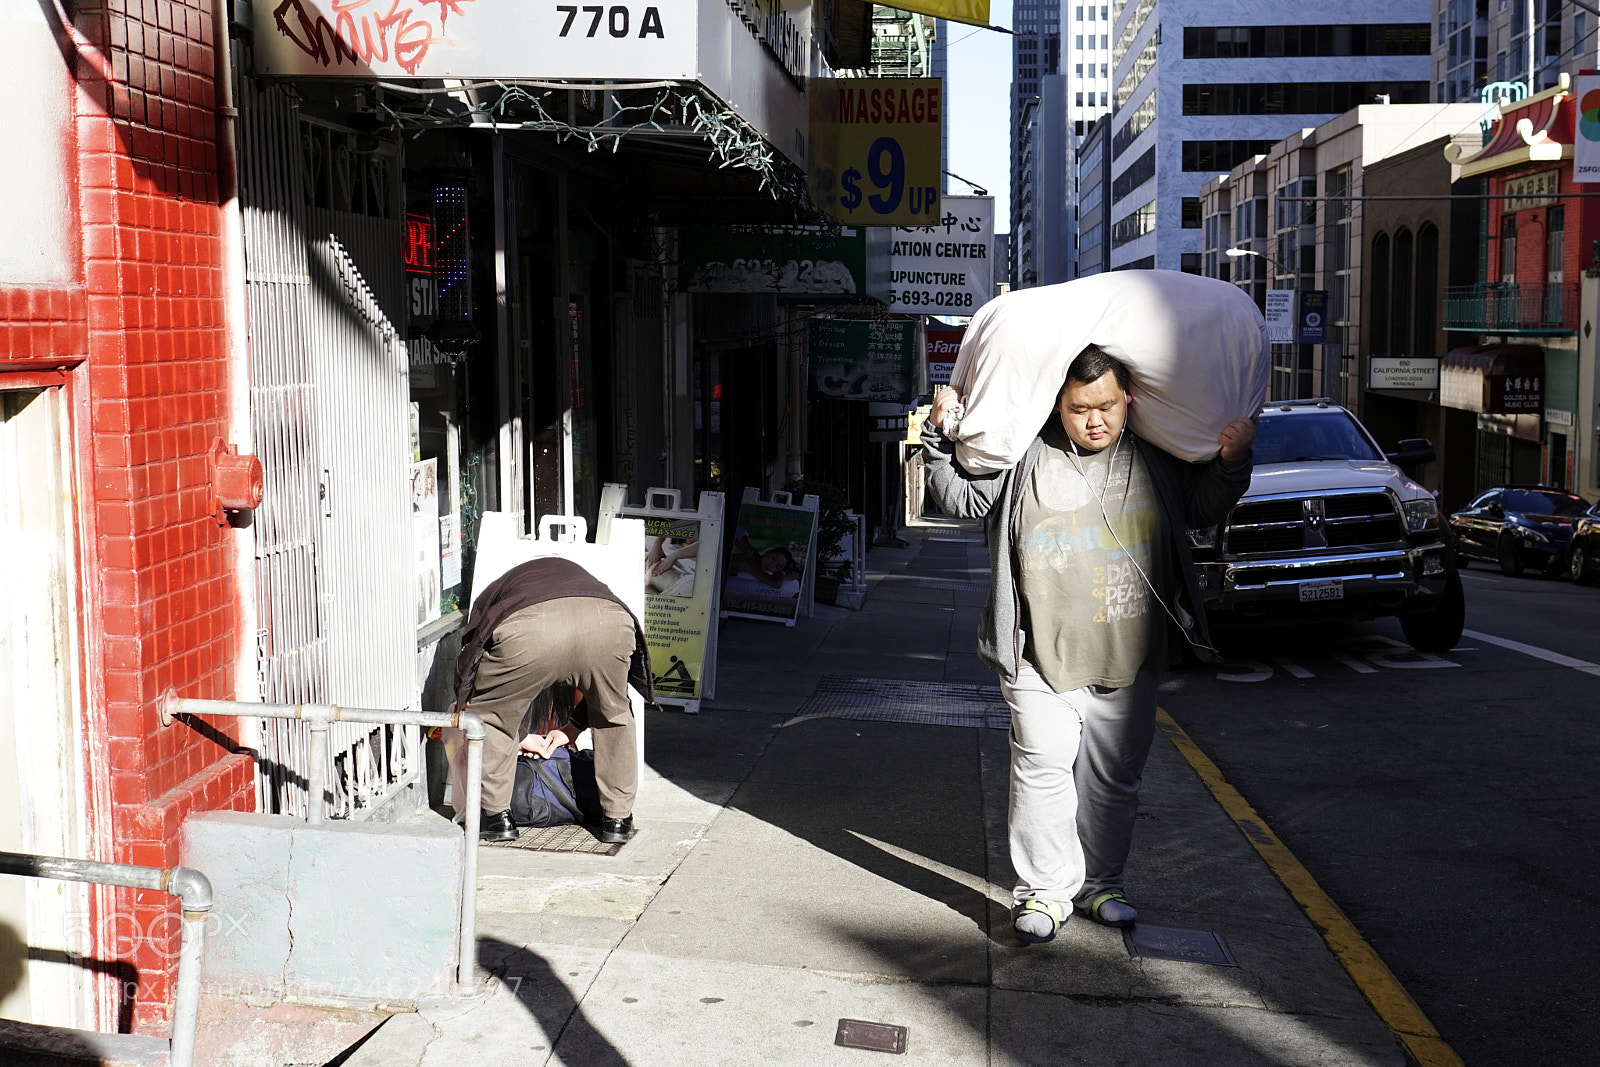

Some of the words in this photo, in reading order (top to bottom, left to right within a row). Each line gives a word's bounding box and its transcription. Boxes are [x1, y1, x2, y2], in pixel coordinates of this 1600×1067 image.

[556, 5, 629, 38] 770
[638, 6, 665, 39] A
[839, 88, 939, 123] MASSAGE
[909, 187, 937, 215] UP
[892, 241, 932, 257] ATION
[936, 242, 987, 258] CENTER
[650, 528, 695, 538] MASSAGE
